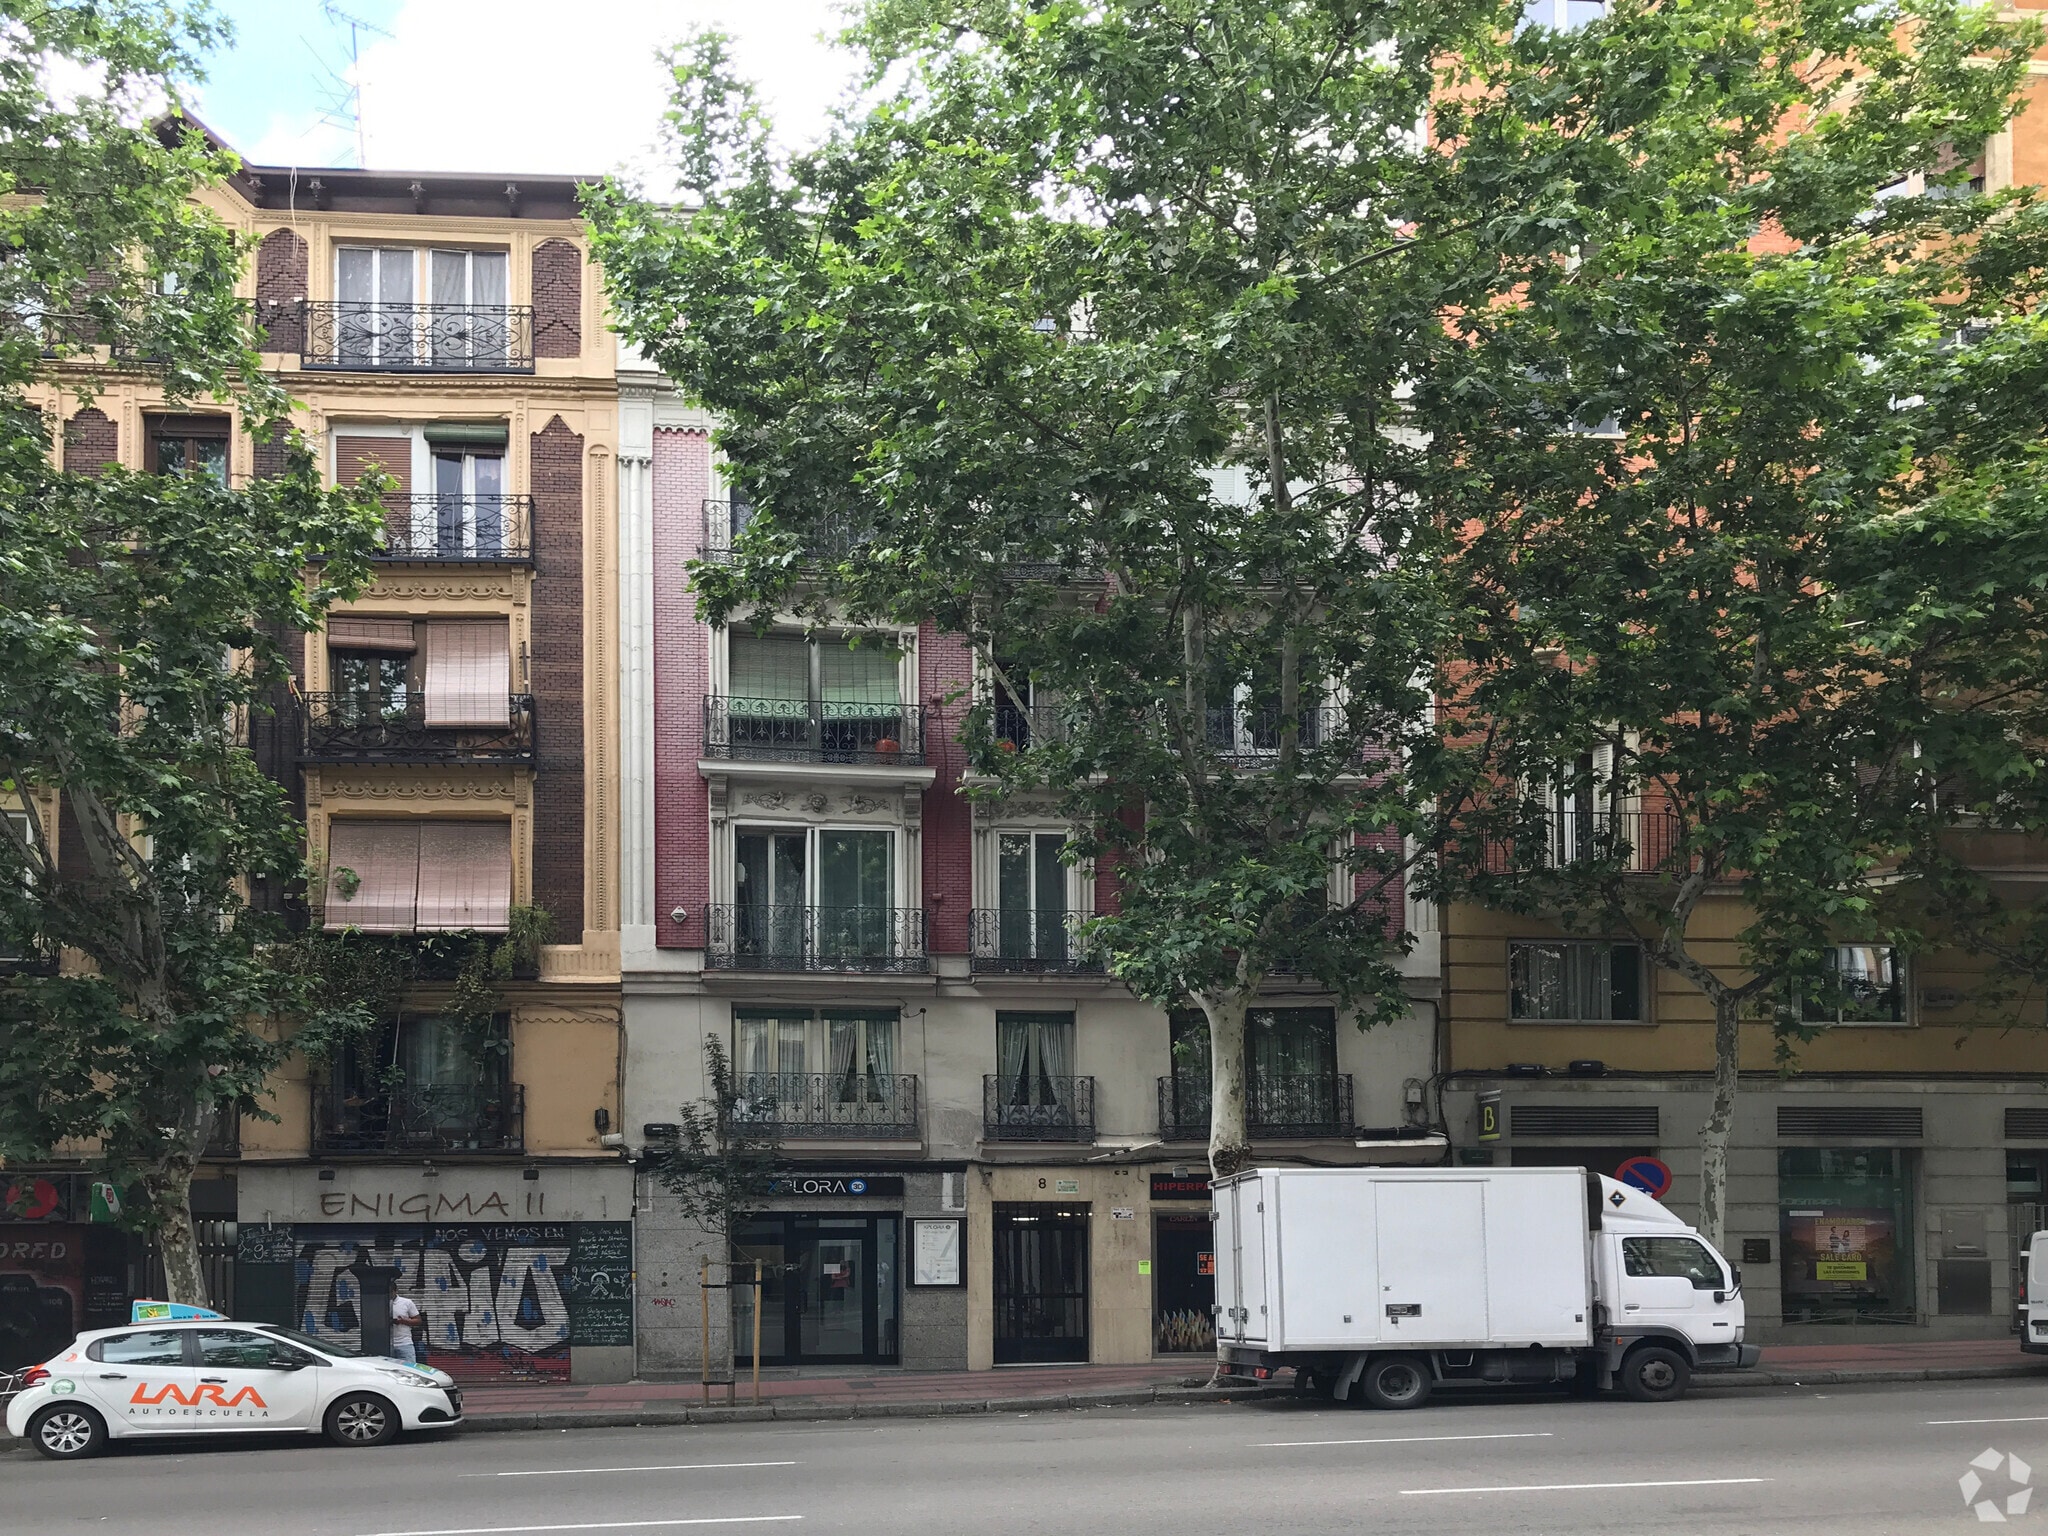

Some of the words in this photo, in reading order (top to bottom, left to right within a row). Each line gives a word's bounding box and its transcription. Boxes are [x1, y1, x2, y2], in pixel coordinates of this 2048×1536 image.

[1038, 1178, 1047, 1189] 8
[320, 1191, 509, 1221] ENIGMA
[527, 1192, 544, 1215] II
[435, 1229, 468, 1241] NOS
[481, 1227, 541, 1240] VEMOS
[544, 1227, 564, 1239] EN
[130, 1383, 268, 1408] LARA
[129, 1408, 269, 1417] AUTOESCUELA
